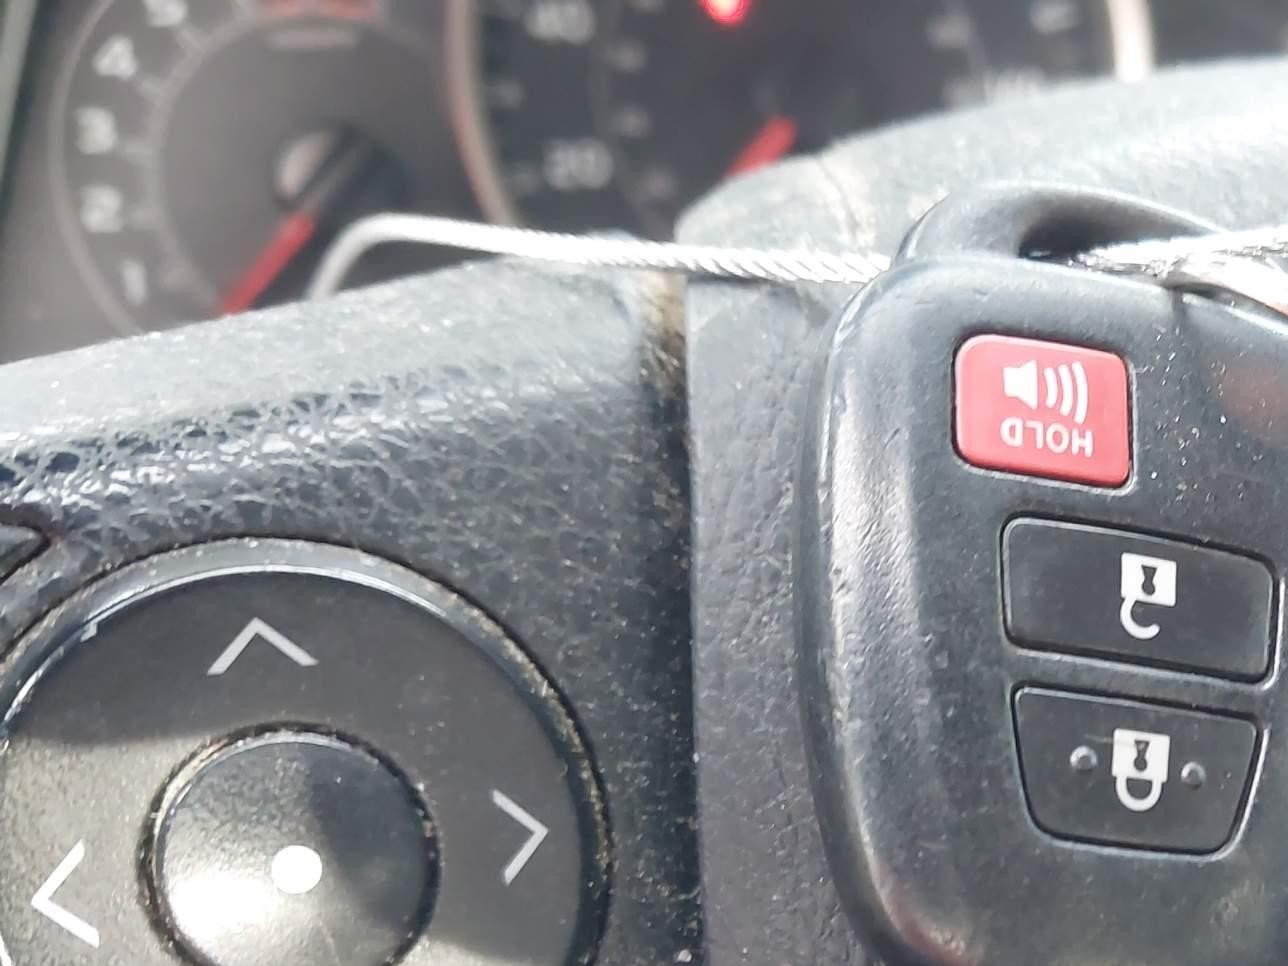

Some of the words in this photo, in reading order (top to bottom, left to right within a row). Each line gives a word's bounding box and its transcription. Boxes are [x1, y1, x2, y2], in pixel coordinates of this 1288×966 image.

[93, 34, 137, 80] 4
[75, 107, 117, 154] 3
[80, 185, 123, 233] 2
[119, 259, 147, 304] 1
[999, 416, 1094, 458] HOLD
